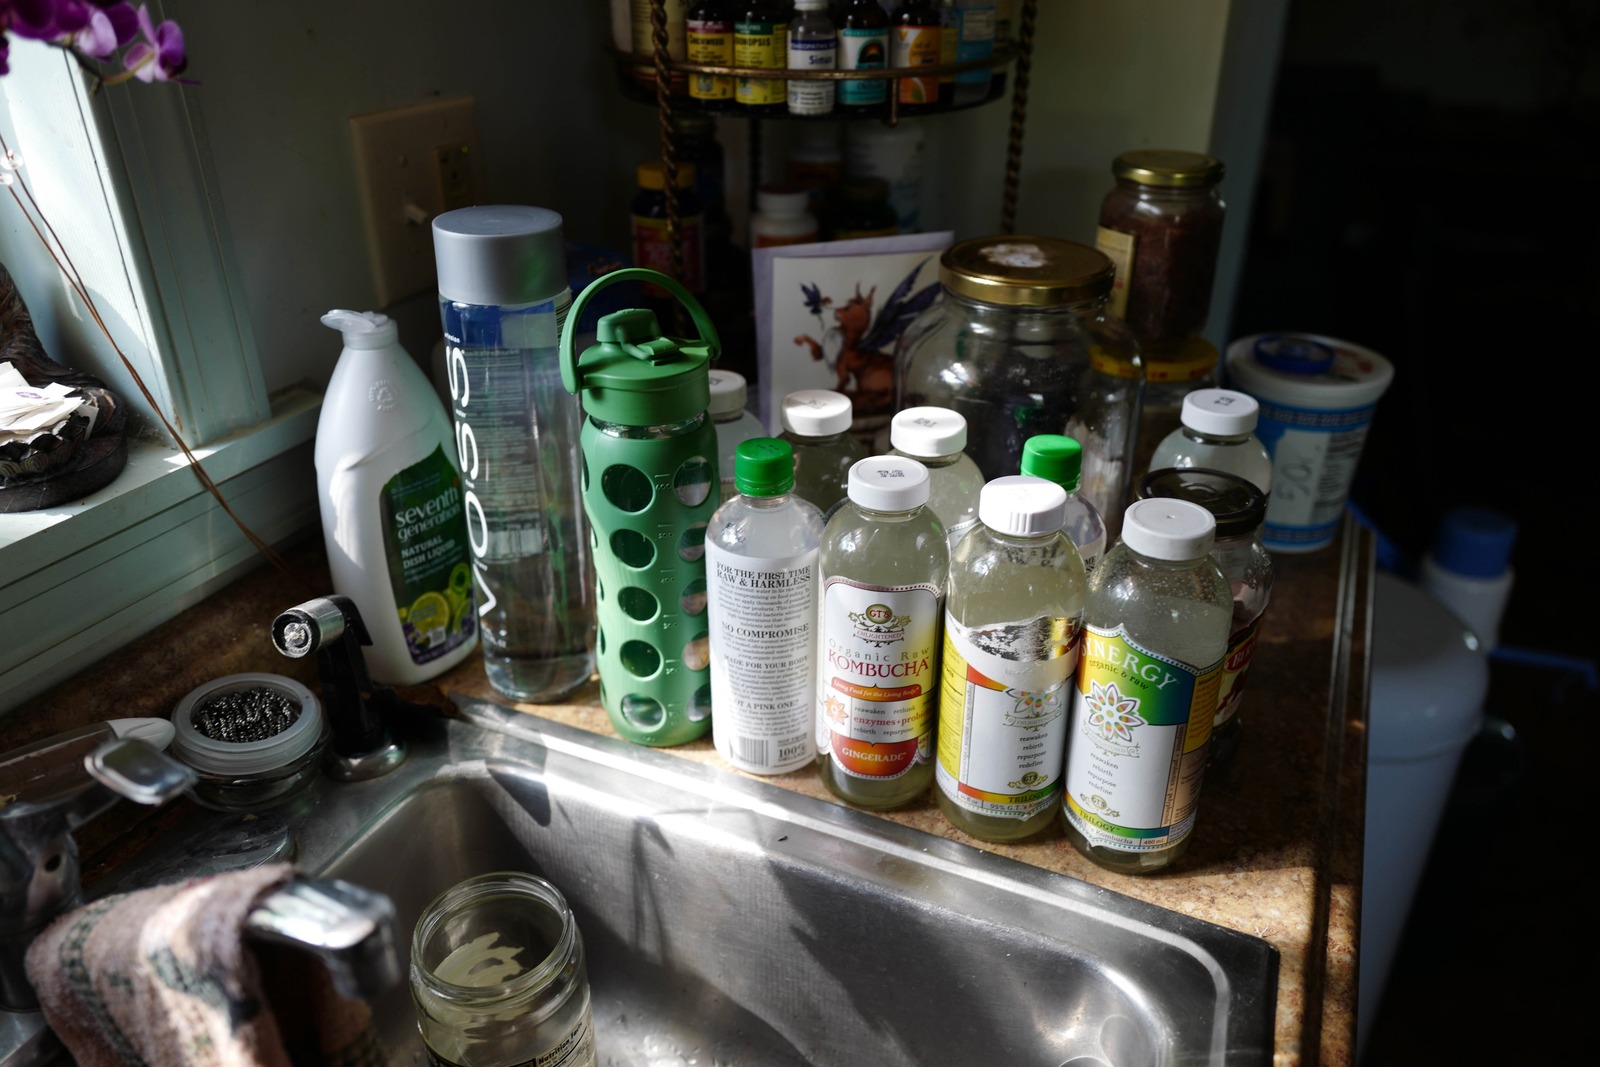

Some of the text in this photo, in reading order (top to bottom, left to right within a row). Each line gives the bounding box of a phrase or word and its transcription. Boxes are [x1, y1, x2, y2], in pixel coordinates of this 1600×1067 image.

[396, 486, 459, 528] seventh
[398, 502, 462, 543] generation
[401, 534, 444, 558] NATURAL
[403, 553, 426, 570] DISH
[427, 538, 456, 560] LIQUID
[717, 562, 811, 580] FOR THE FIRST TIME
[717, 570, 811, 588] RAW & HARMLESS
[869, 610, 889, 618] GT'S
[722, 620, 809, 638] NO COMPROMISE
[857, 630, 902, 640] ENLIGHTENED
[829, 638, 929, 661] Organic Raw
[745, 660, 762, 668] FOR
[765, 660, 787, 669] YOUR
[789, 655, 809, 666] BODY
[829, 649, 929, 678] KOMBUCHA
[1089, 660, 1118, 675] organic
[1130, 676, 1150, 690] raw
[834, 680, 848, 692] Living
[849, 687, 863, 695] Food
[903, 688, 916, 696] Body
[855, 705, 915, 714] reawaken rethink
[854, 716, 896, 727] enzymes
[854, 726, 913, 736] rebirth repurpose
[1019, 732, 1048, 742] reawaken
[842, 747, 904, 761] GINGERADE
[1022, 742, 1043, 751] rebirth
[1017, 751, 1046, 760] repurpose
[1090, 752, 1119, 770] reawaken
[1018, 760, 1043, 769] redefine
[1092, 764, 1113, 777] rebirth
[1087, 770, 1117, 788] repurpose
[1088, 780, 1112, 796] redefine
[1078, 810, 1116, 832] TRILOGY
[1095, 828, 1133, 845] Kombucha
[539, 1039, 570, 1064] Nutrition
